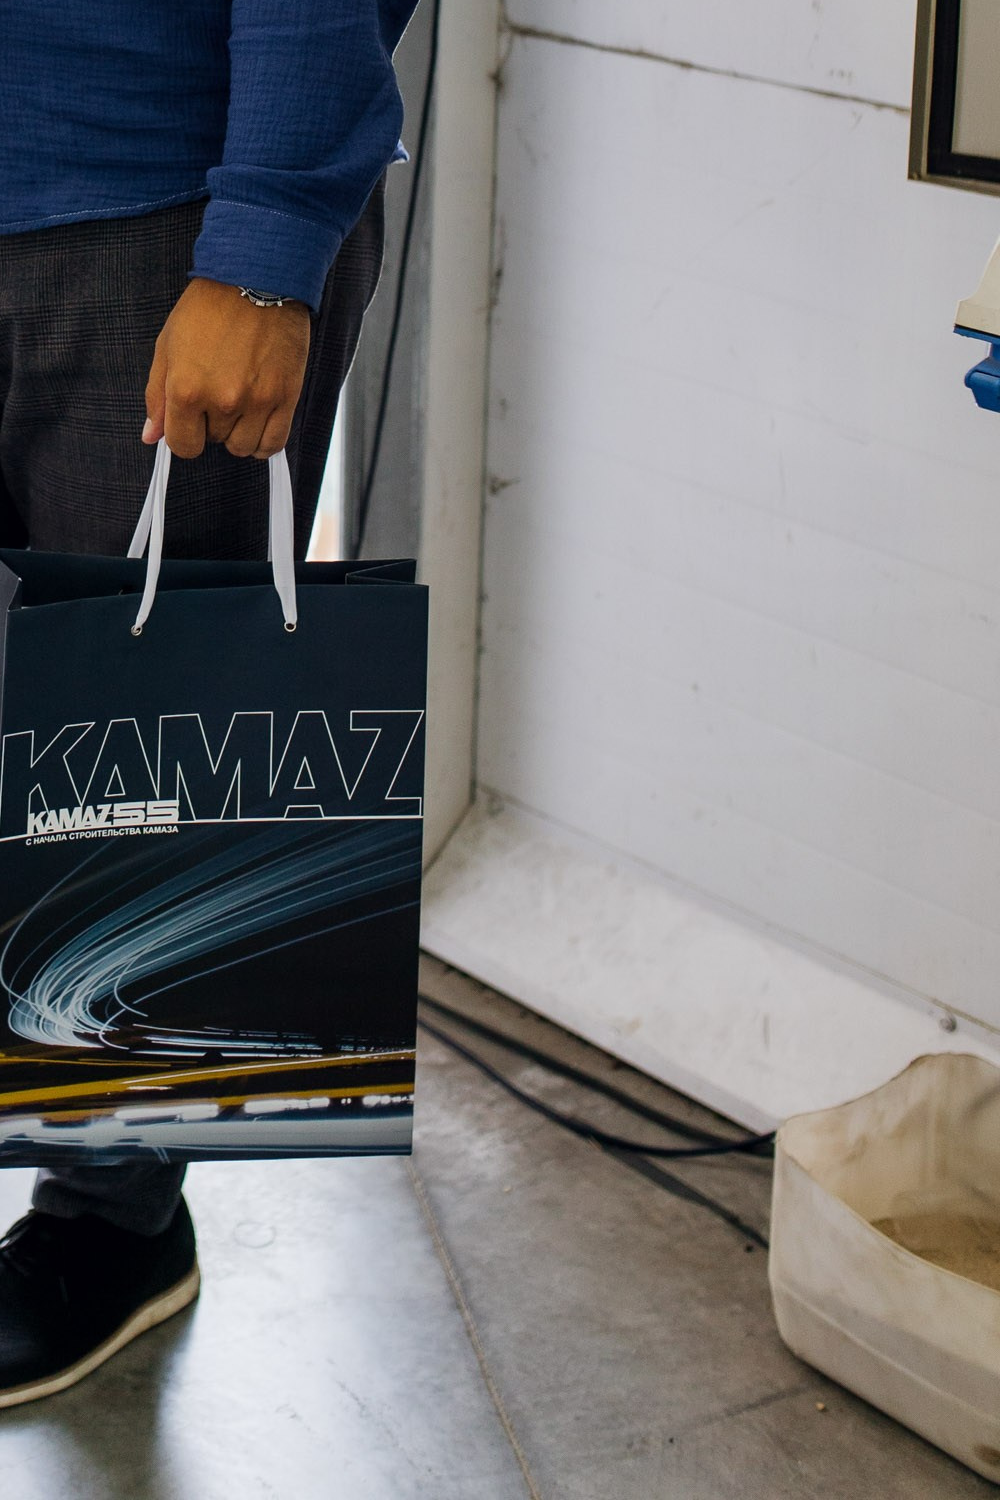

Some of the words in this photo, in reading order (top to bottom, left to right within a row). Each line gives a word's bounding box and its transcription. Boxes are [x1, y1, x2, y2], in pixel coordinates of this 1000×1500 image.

[25, 838, 32, 846] С
[33, 833, 68, 845] НАЧАЛА
[68, 827, 142, 841] СТРОИТЕЛЬСТВА
[142, 825, 179, 835] КАМАЗА
